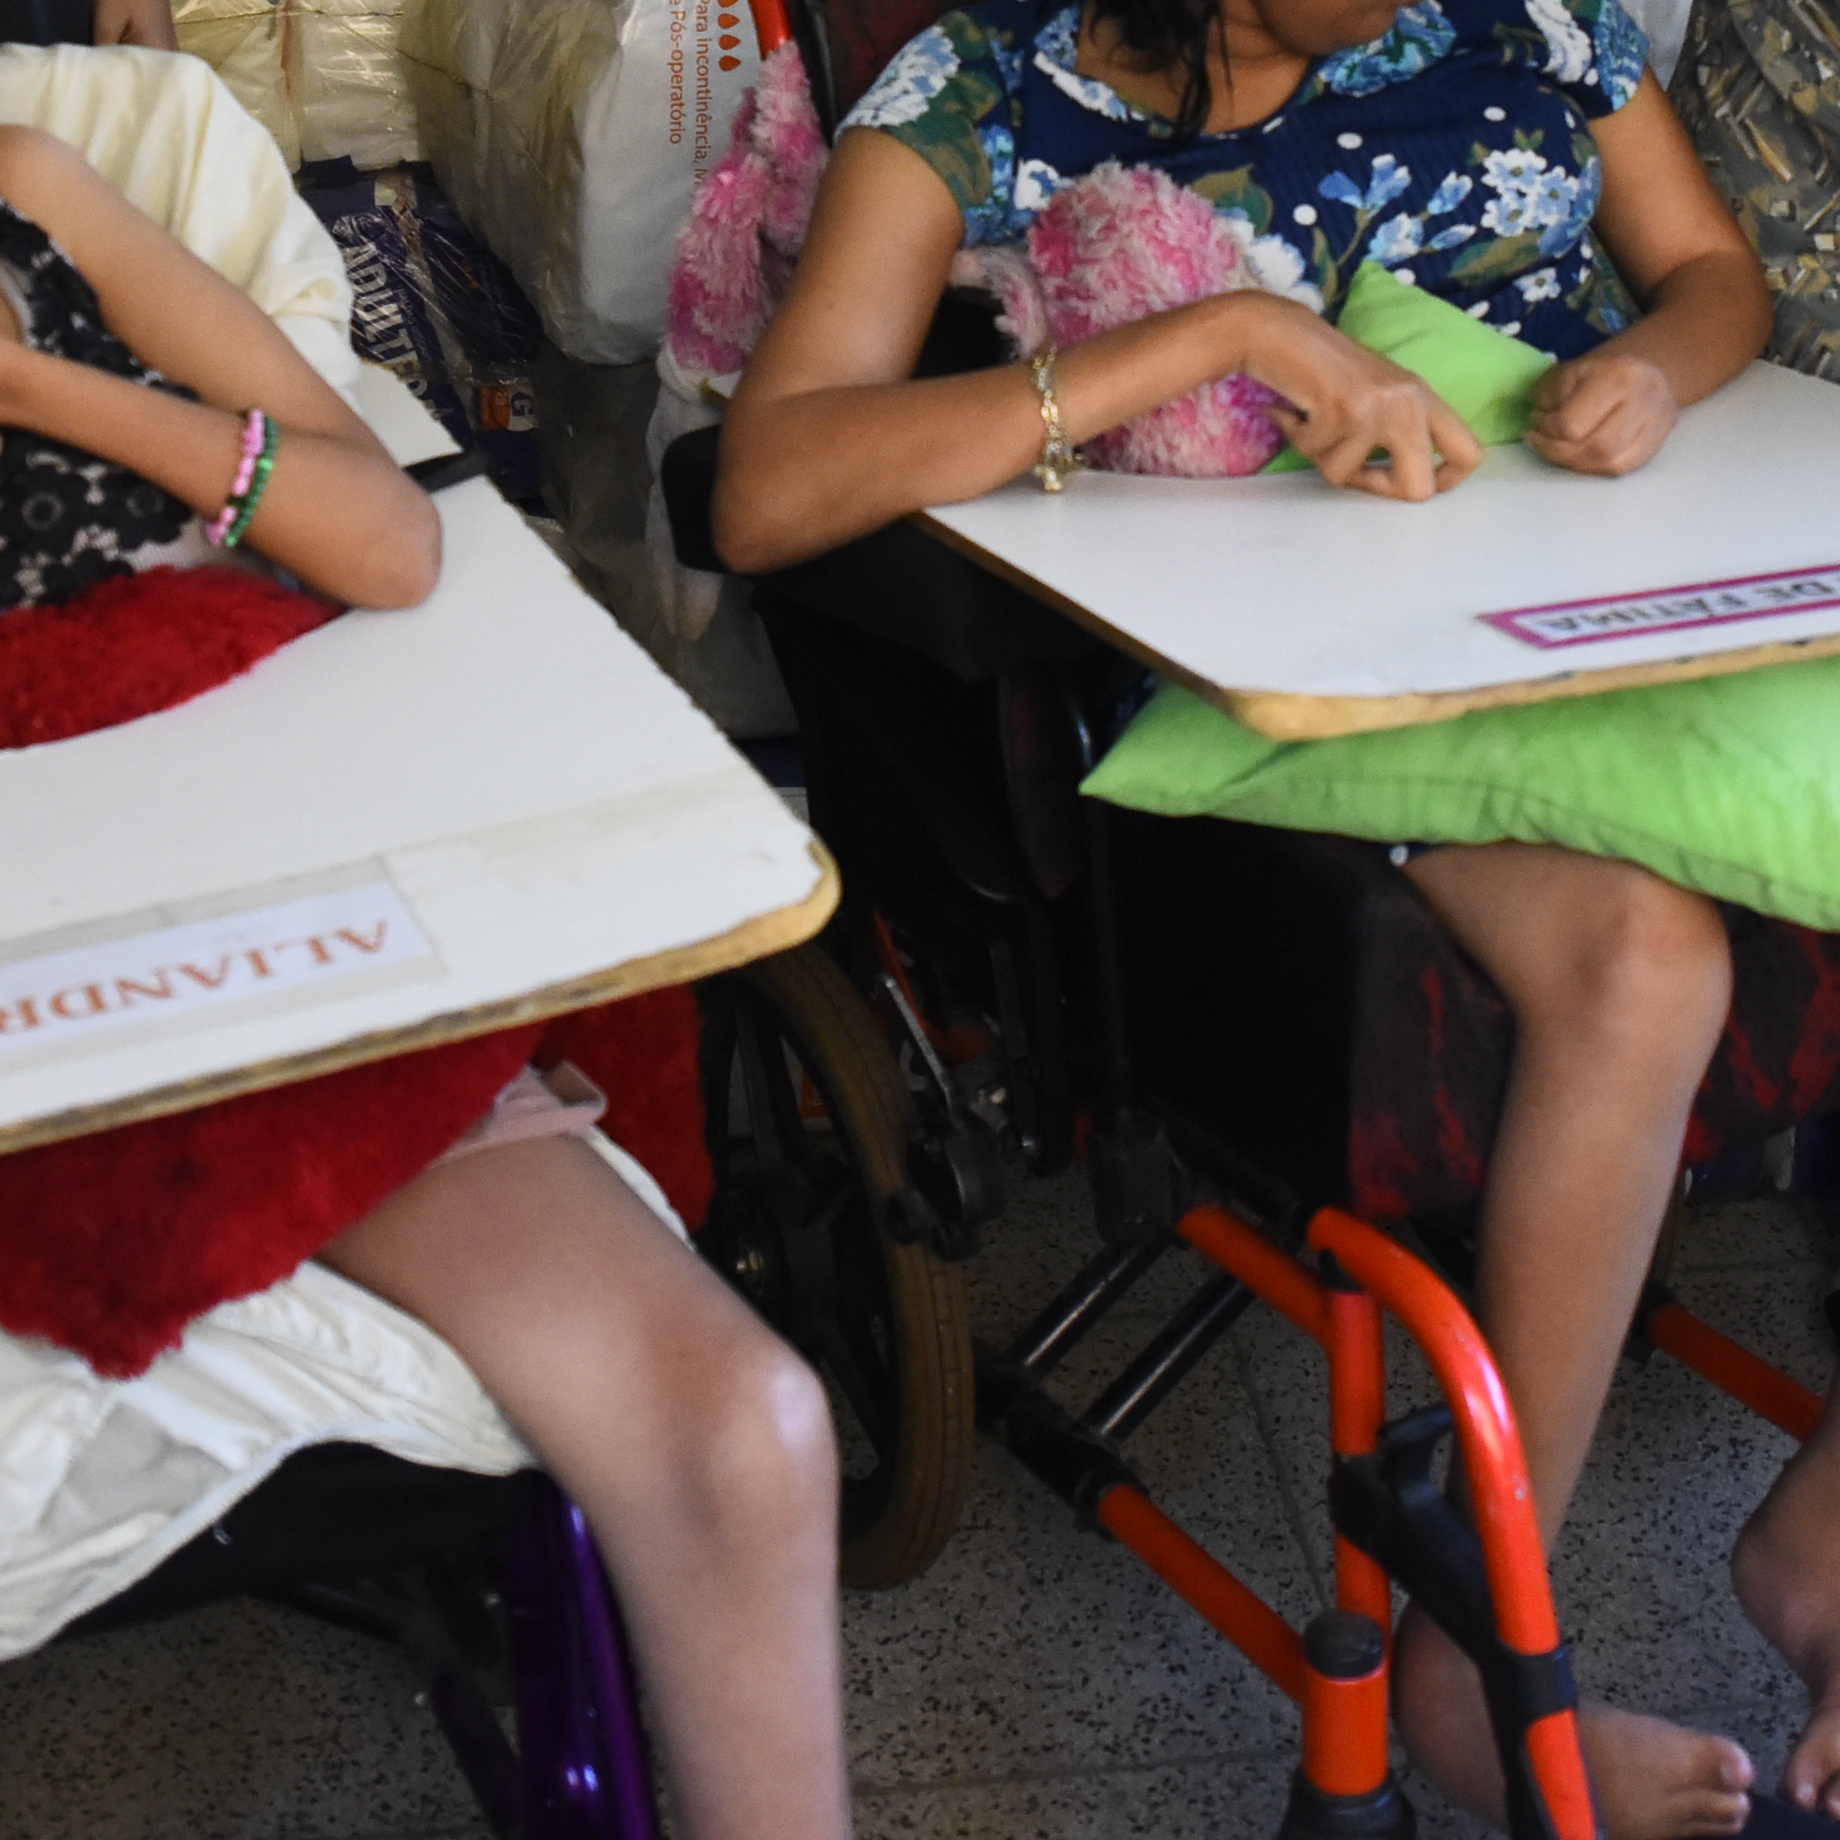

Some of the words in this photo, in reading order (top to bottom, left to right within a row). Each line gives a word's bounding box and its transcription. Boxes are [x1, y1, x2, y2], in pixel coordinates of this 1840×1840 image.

[667, 10, 687, 145] Pós-operatório
[693, 37, 713, 166] incontinência,
[1537, 592, 1749, 634] FÁTIMA
[1755, 581, 1837, 604] DE
